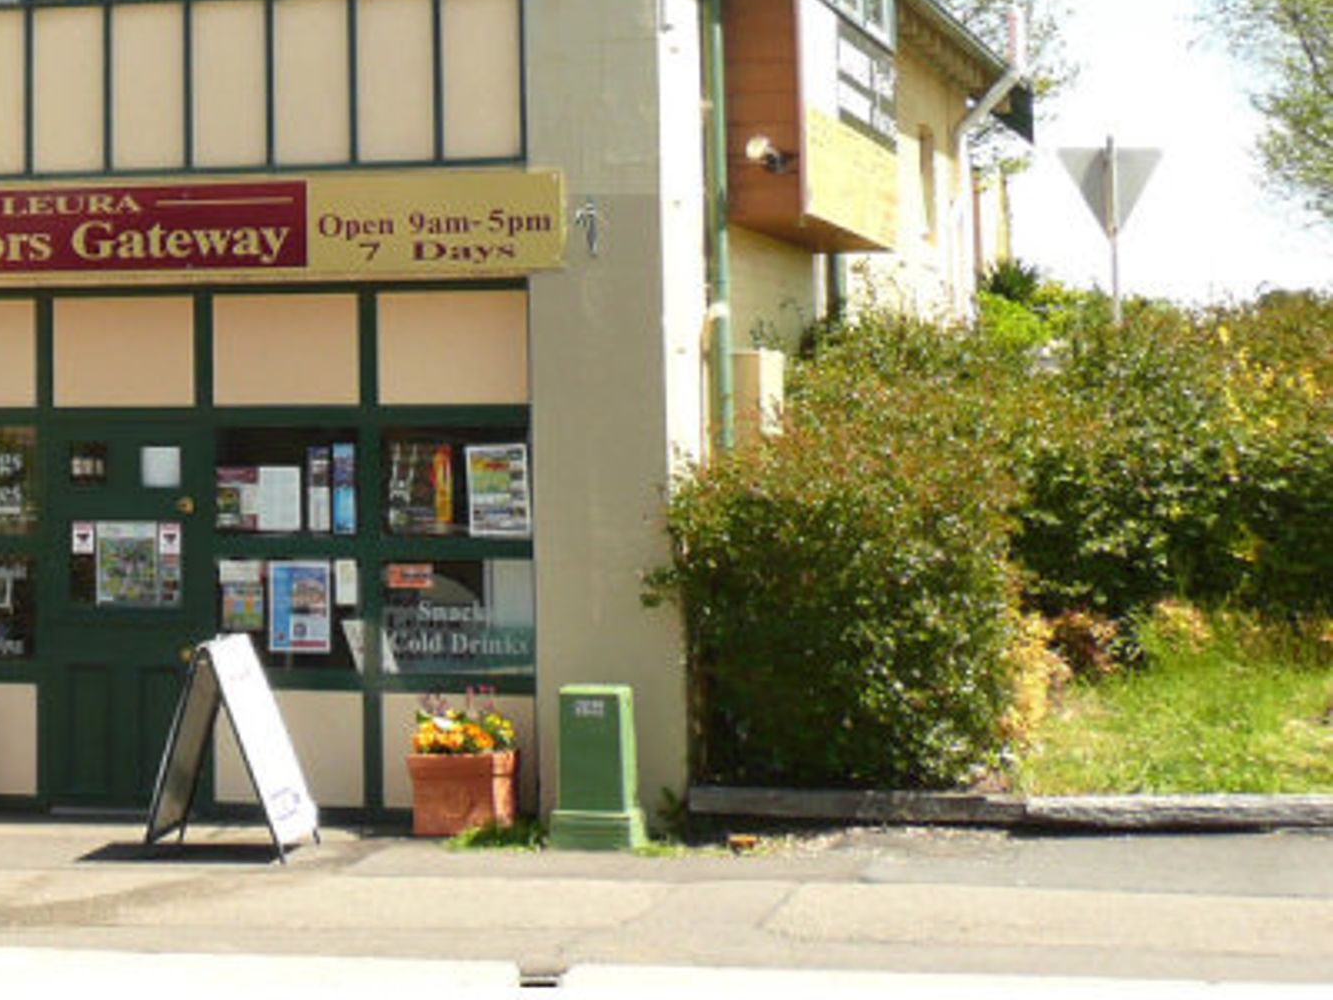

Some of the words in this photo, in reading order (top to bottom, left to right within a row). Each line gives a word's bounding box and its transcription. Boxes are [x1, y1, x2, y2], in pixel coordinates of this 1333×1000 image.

[2, 195, 142, 215] LEURA
[318, 212, 395, 241] Open
[407, 208, 554, 238] 9am-5pm
[70, 218, 290, 264] Gateway
[358, 242, 381, 263] 7
[410, 239, 518, 265] Days
[418, 599, 490, 622] Snack
